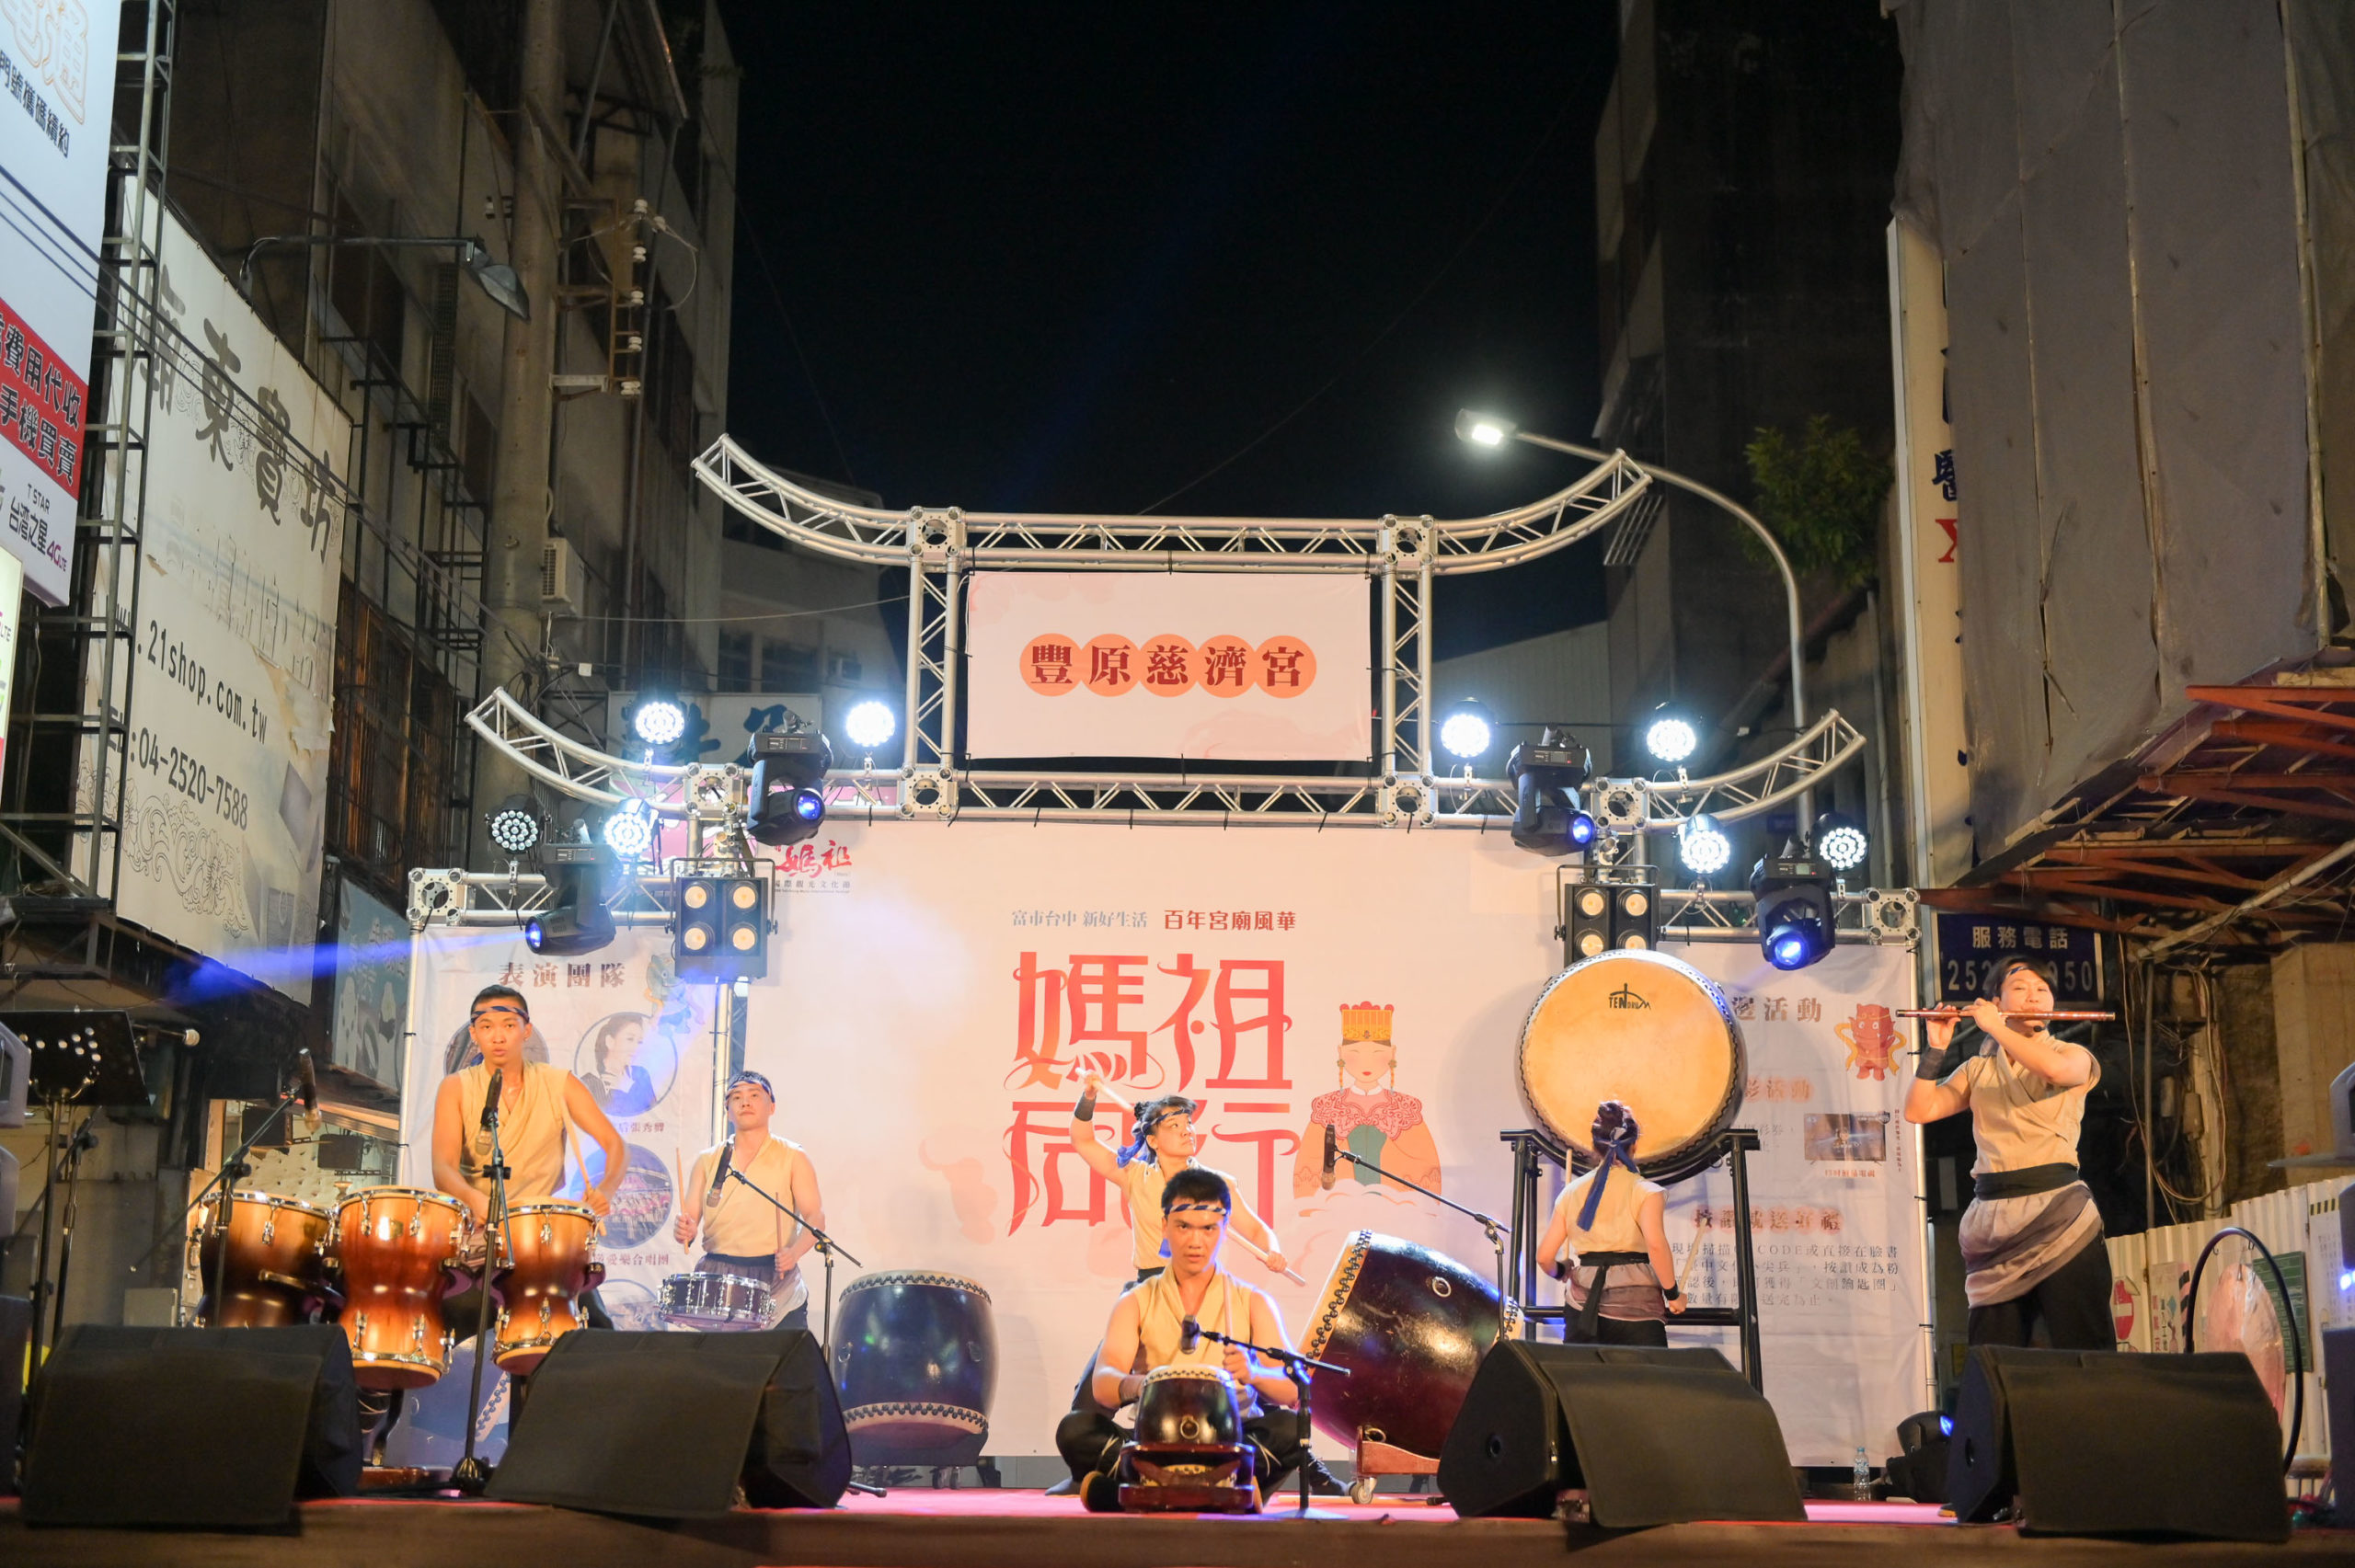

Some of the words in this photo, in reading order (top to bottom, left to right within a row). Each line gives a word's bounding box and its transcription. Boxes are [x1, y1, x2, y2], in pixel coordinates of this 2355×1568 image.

[0, 313, 81, 432] 費用代收
[0, 383, 77, 486] 手機買賣
[32, 488, 51, 515] STAR
[1030, 643, 1306, 691] 豐原慈濟宮
[775, 840, 853, 879] 媽祖
[1011, 909, 1076, 927] 富市台中
[1083, 910, 1148, 928] 新好生活
[1163, 909, 1297, 932] 百年宮廟風華
[1972, 925, 2068, 950] 服務電話
[500, 962, 626, 989] 表演團隊
[1004, 951, 1292, 1093] 媽祖
